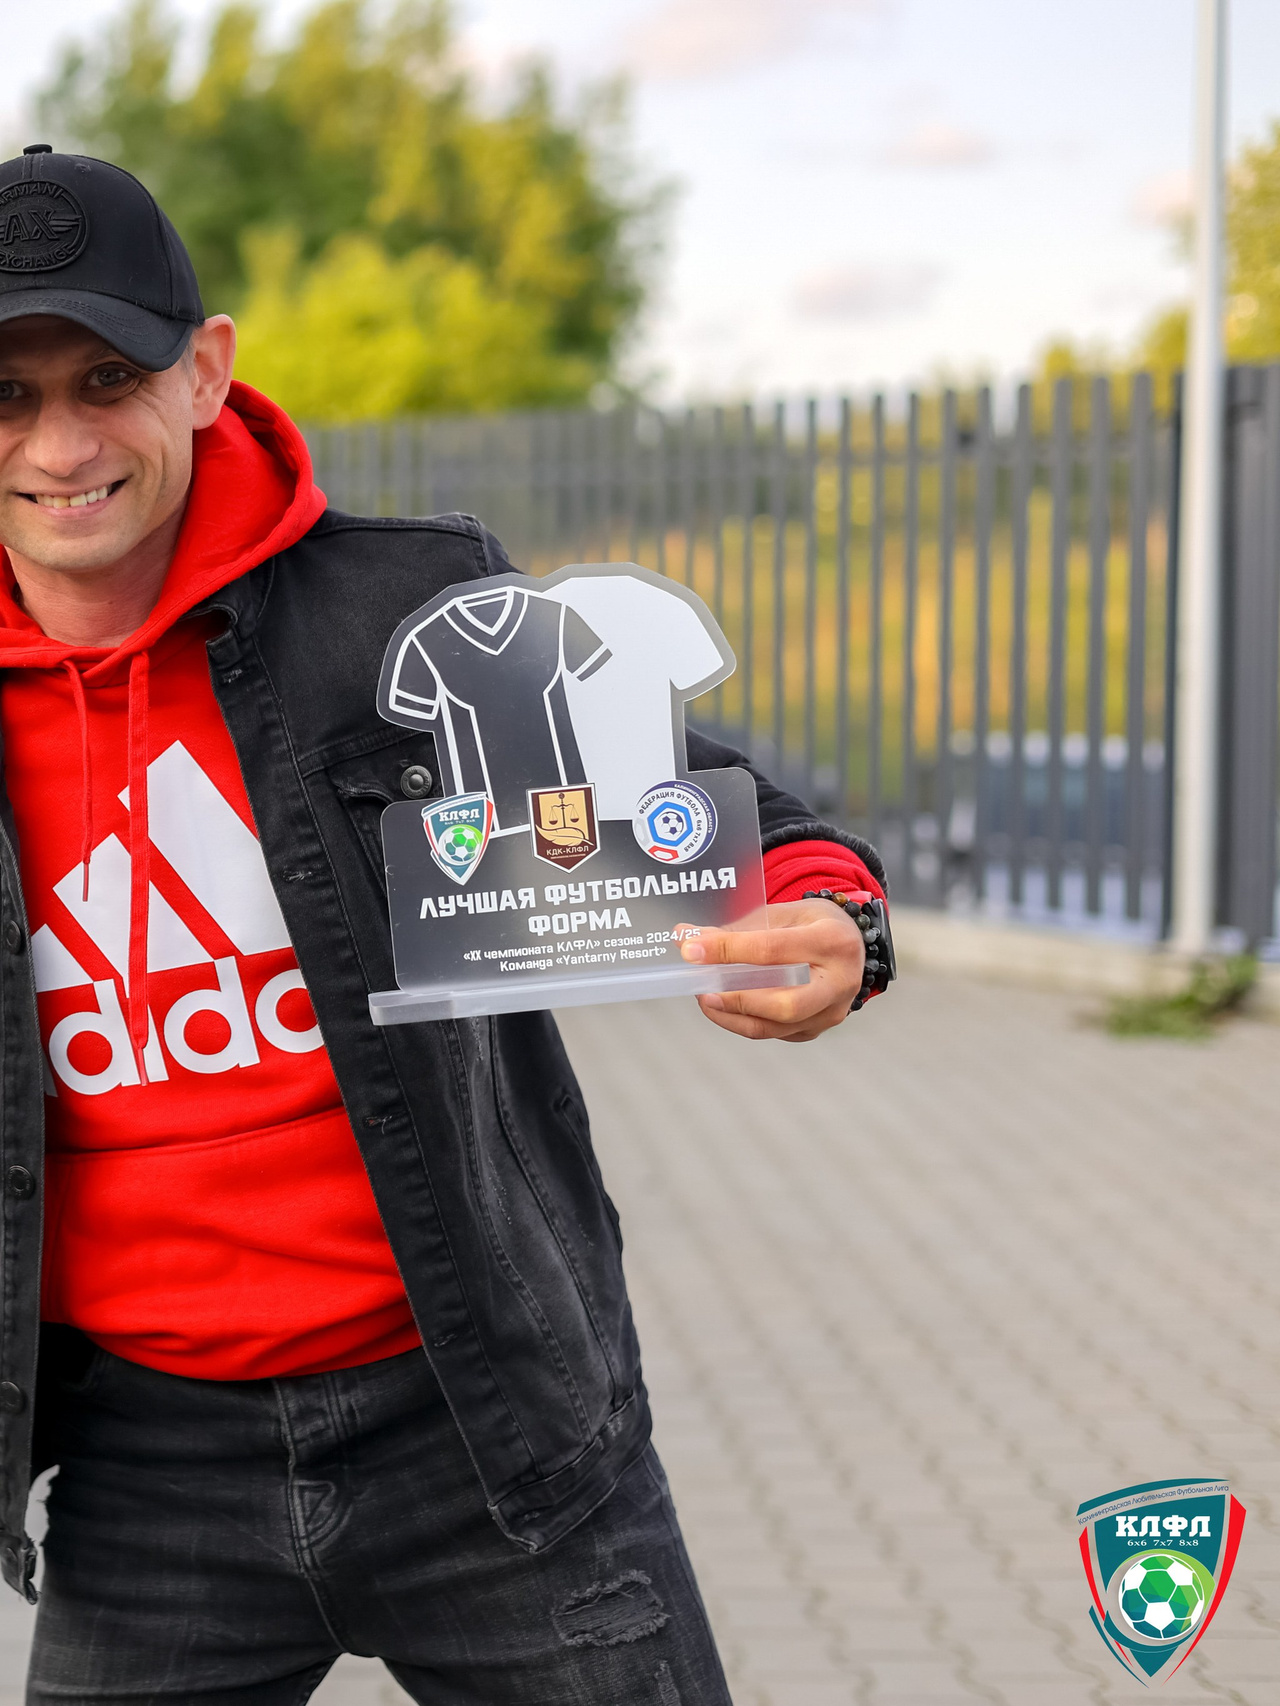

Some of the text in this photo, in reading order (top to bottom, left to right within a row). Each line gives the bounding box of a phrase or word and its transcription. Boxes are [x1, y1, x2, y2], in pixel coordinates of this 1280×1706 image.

[3, 210, 60, 244] AX
[438, 808, 481, 822] КЛФЛ
[639, 792, 675, 814] ФЕДЕРАЦИЯ
[676, 793, 700, 816] ФУТБОЛА
[546, 845, 589, 856] КДК-КЛФЛ
[420, 867, 737, 920] ЛУЧШАЯ ФУТБОЛЬНАЯ
[528, 907, 632, 937] ФОРМА
[484, 944, 554, 960] чемпионата
[557, 938, 601, 953] КЛФЛ»
[603, 936, 644, 948] сезона
[500, 946, 667, 972] Команда «Yantarny Resort»
